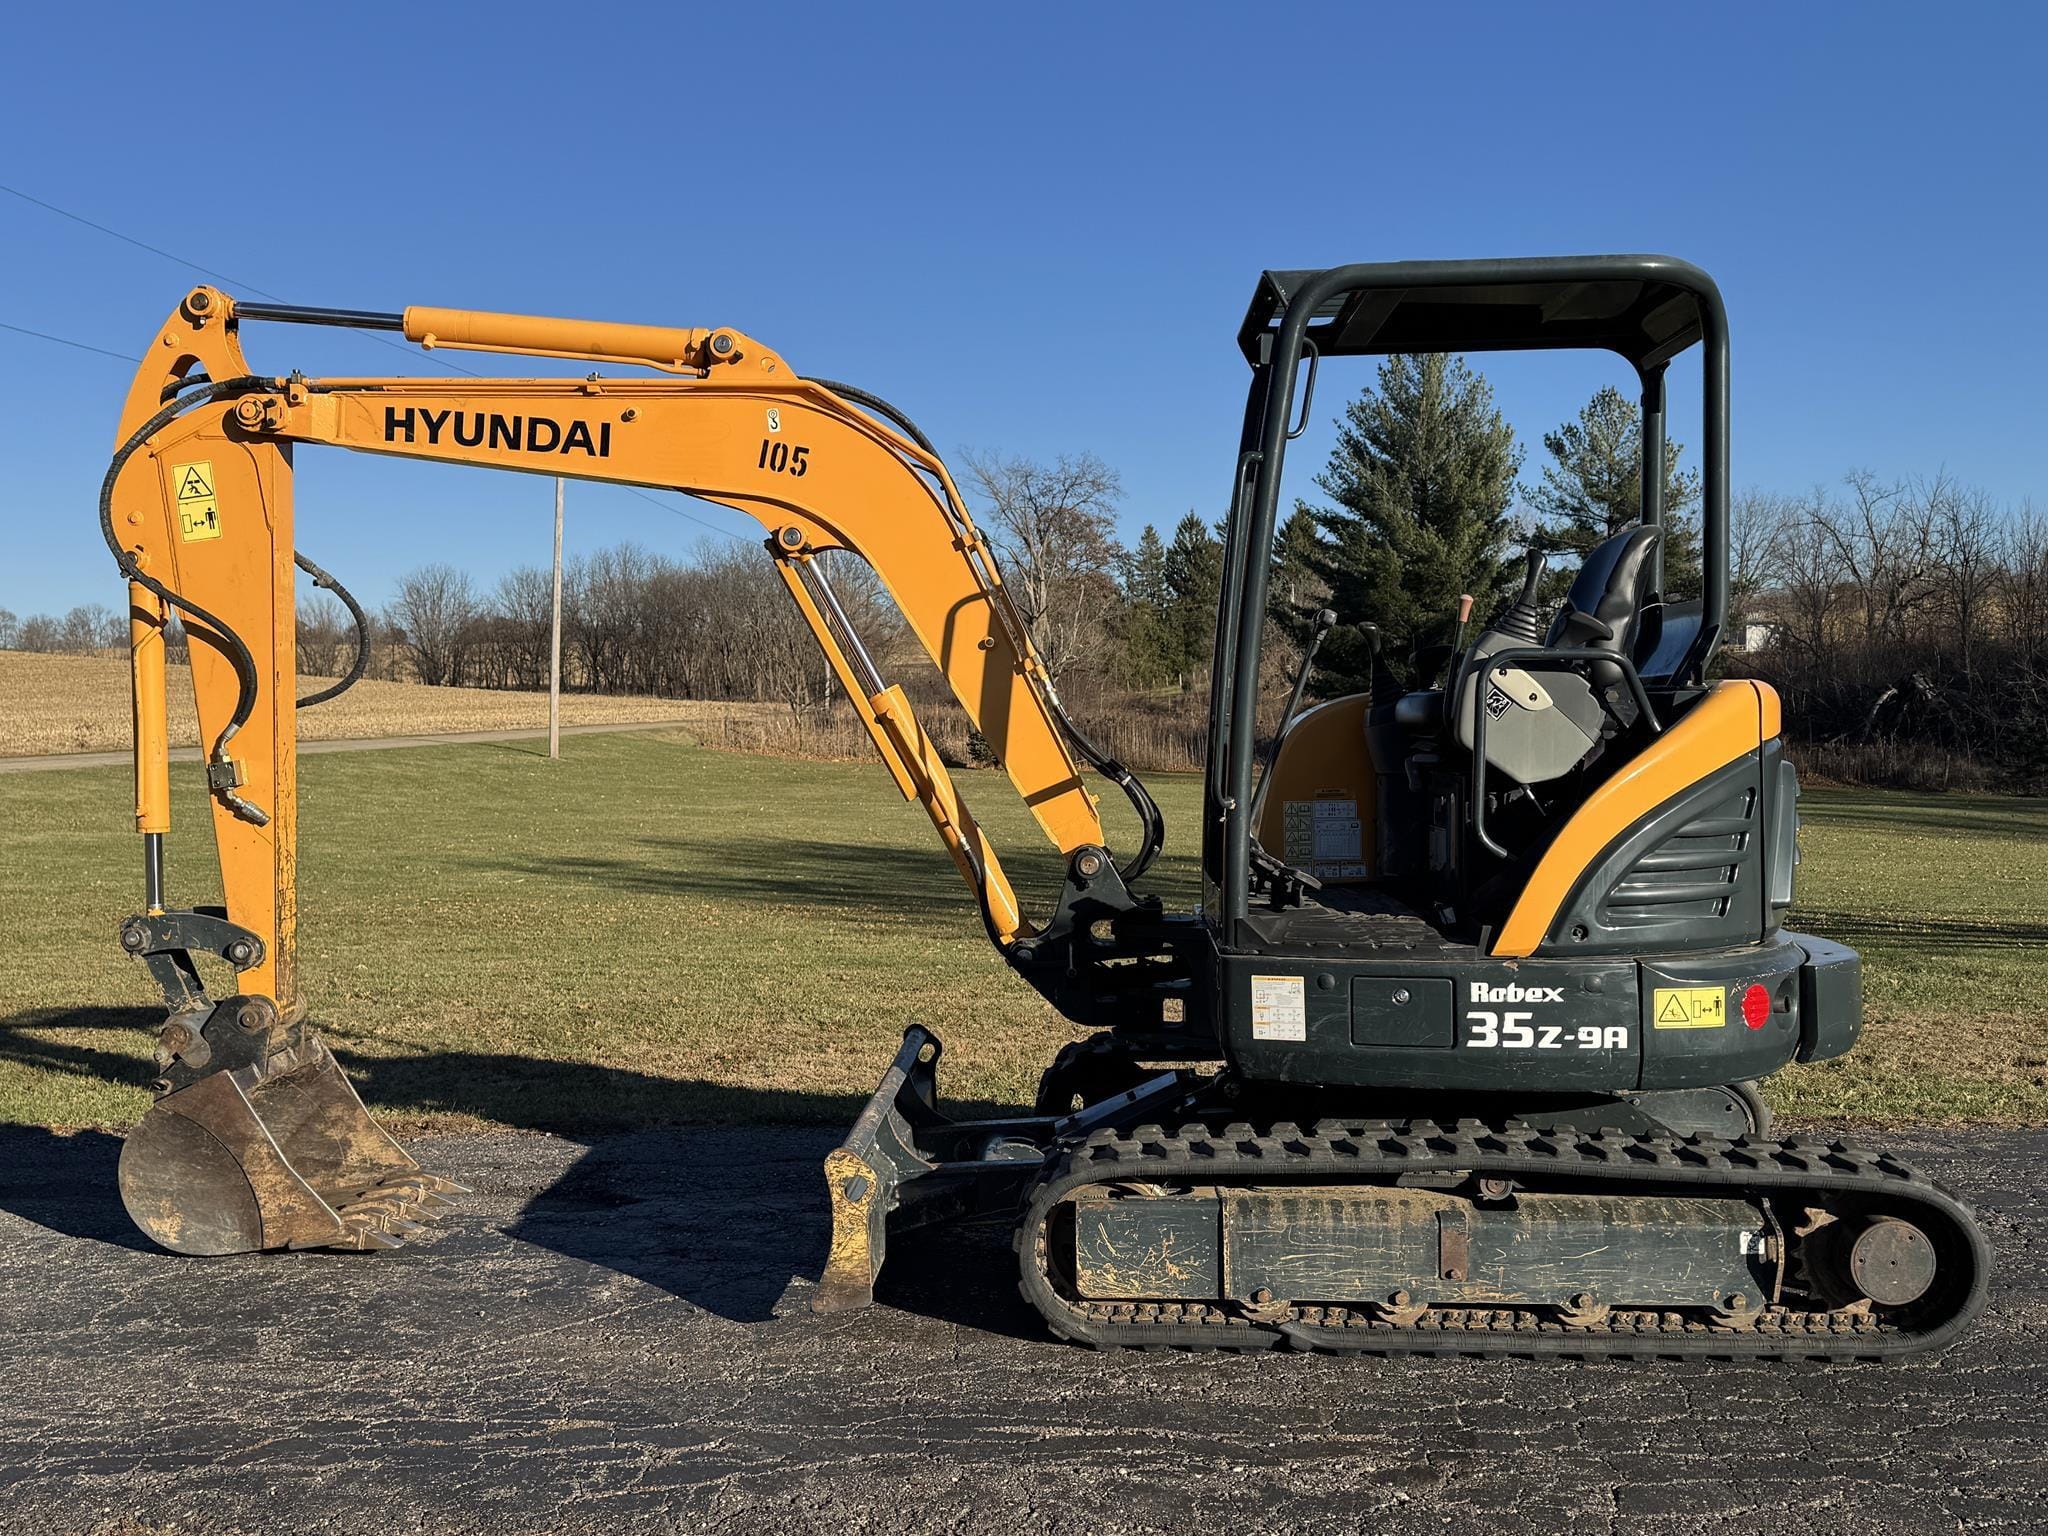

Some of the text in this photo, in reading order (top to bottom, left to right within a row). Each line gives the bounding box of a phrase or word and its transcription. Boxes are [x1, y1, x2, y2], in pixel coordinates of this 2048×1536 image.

[384, 406, 611, 458] HYUNDAI
[758, 438, 810, 477] 105
[1470, 981, 1565, 1003] Robex
